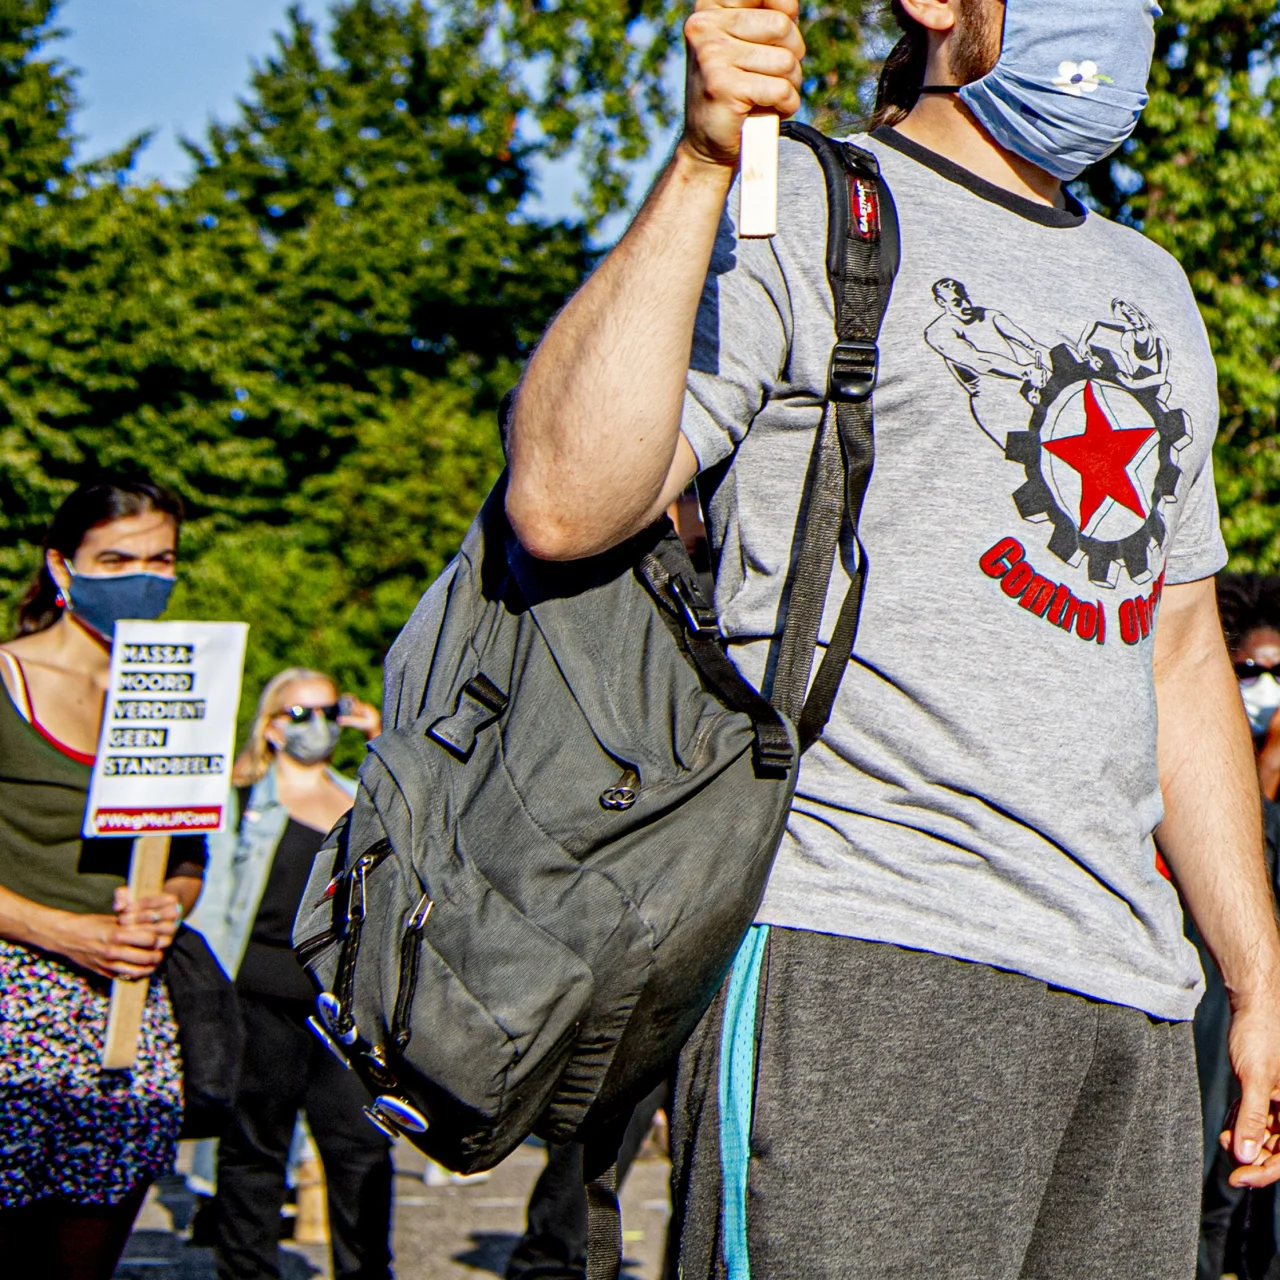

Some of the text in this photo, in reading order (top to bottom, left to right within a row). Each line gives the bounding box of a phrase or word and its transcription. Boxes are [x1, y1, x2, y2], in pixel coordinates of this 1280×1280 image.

[978, 535, 1107, 646] Control
[118, 673, 192, 692] MOORD
[113, 700, 206, 720] VERDIENT
[108, 729, 165, 748] GEEN
[103, 756, 224, 776] STANDBEELD
